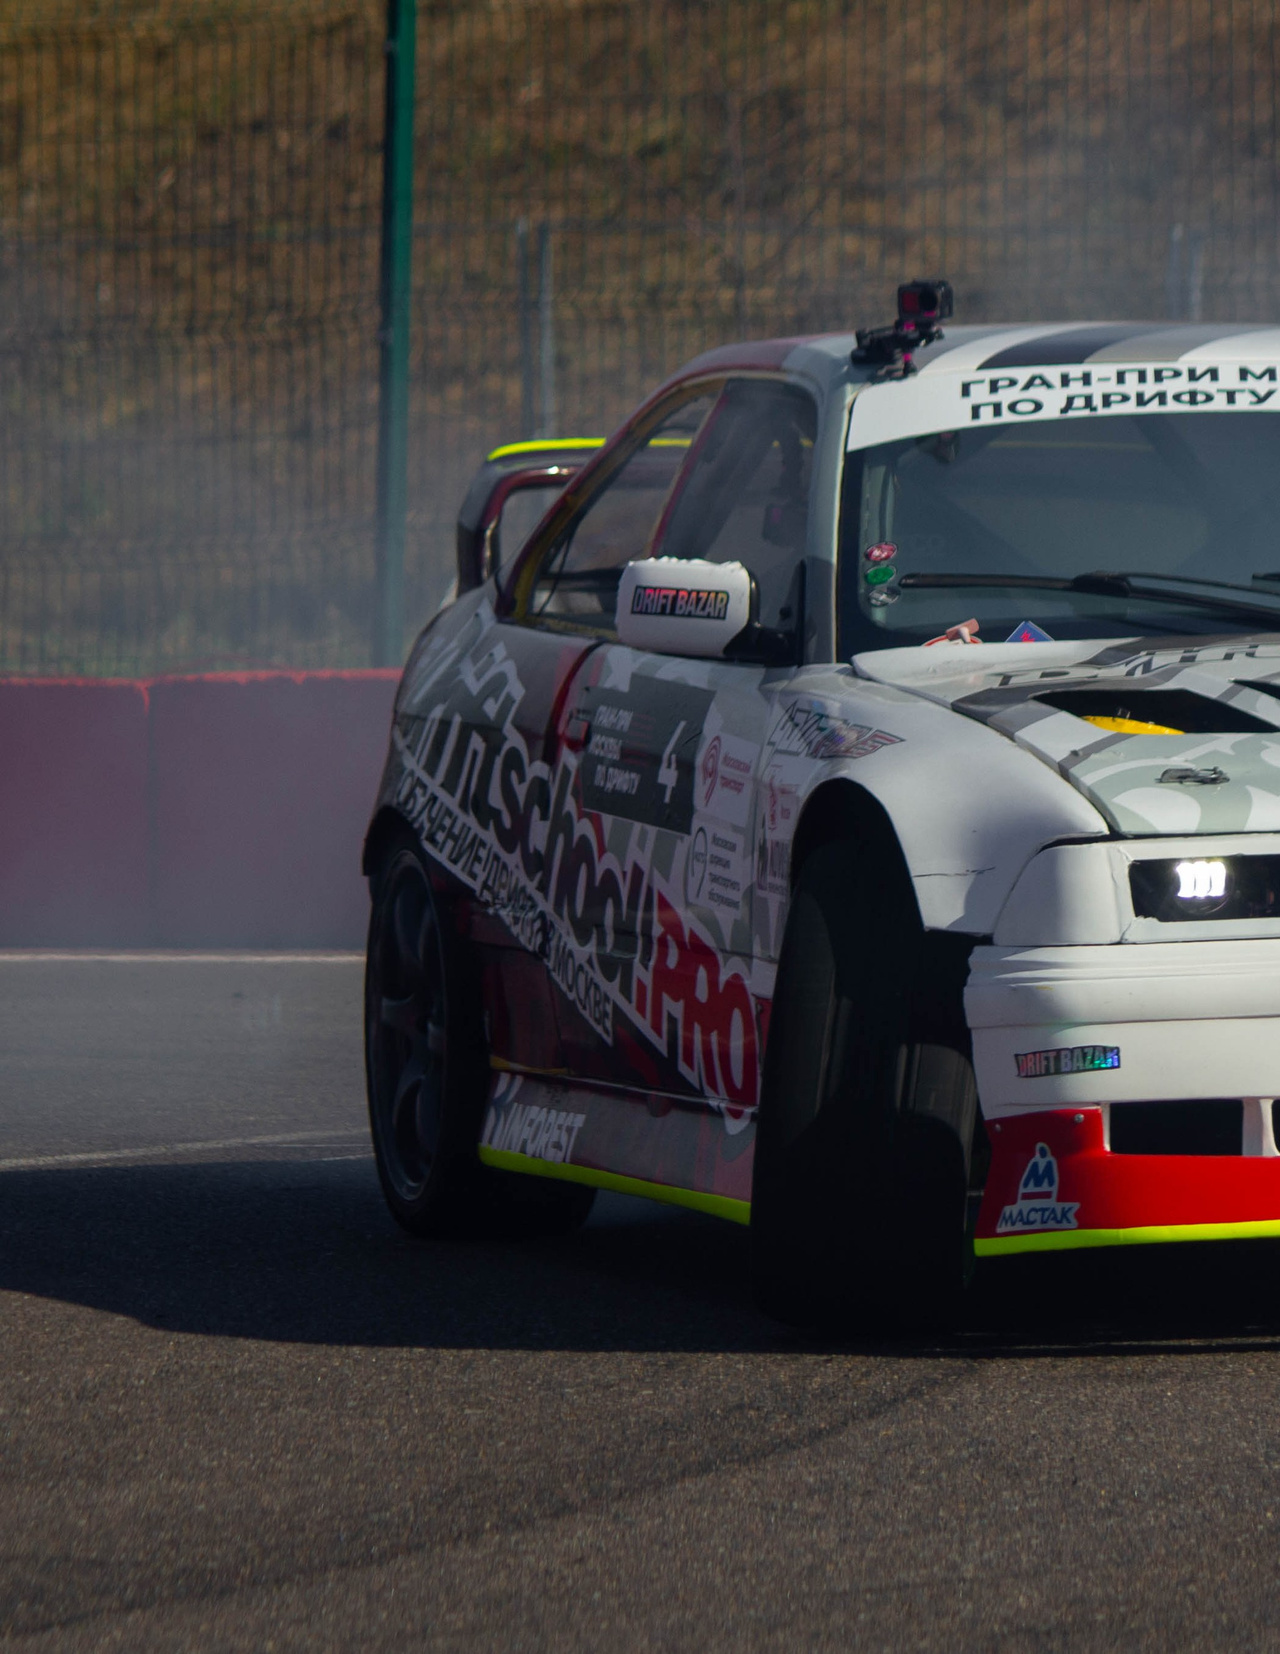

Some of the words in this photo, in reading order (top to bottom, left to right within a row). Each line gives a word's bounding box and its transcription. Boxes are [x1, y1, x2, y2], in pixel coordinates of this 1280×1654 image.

[960, 366, 1219, 398] ГРАН-ПРИ
[970, 398, 1044, 421] ПО
[1060, 388, 1279, 416] ДРИФТУ
[634, 586, 677, 615] DRIFT
[674, 588, 728, 618] BAZAR
[657, 720, 686, 804] 4
[1017, 1050, 1058, 1078] DRIFT
[999, 1205, 1075, 1229] МАСТАК
